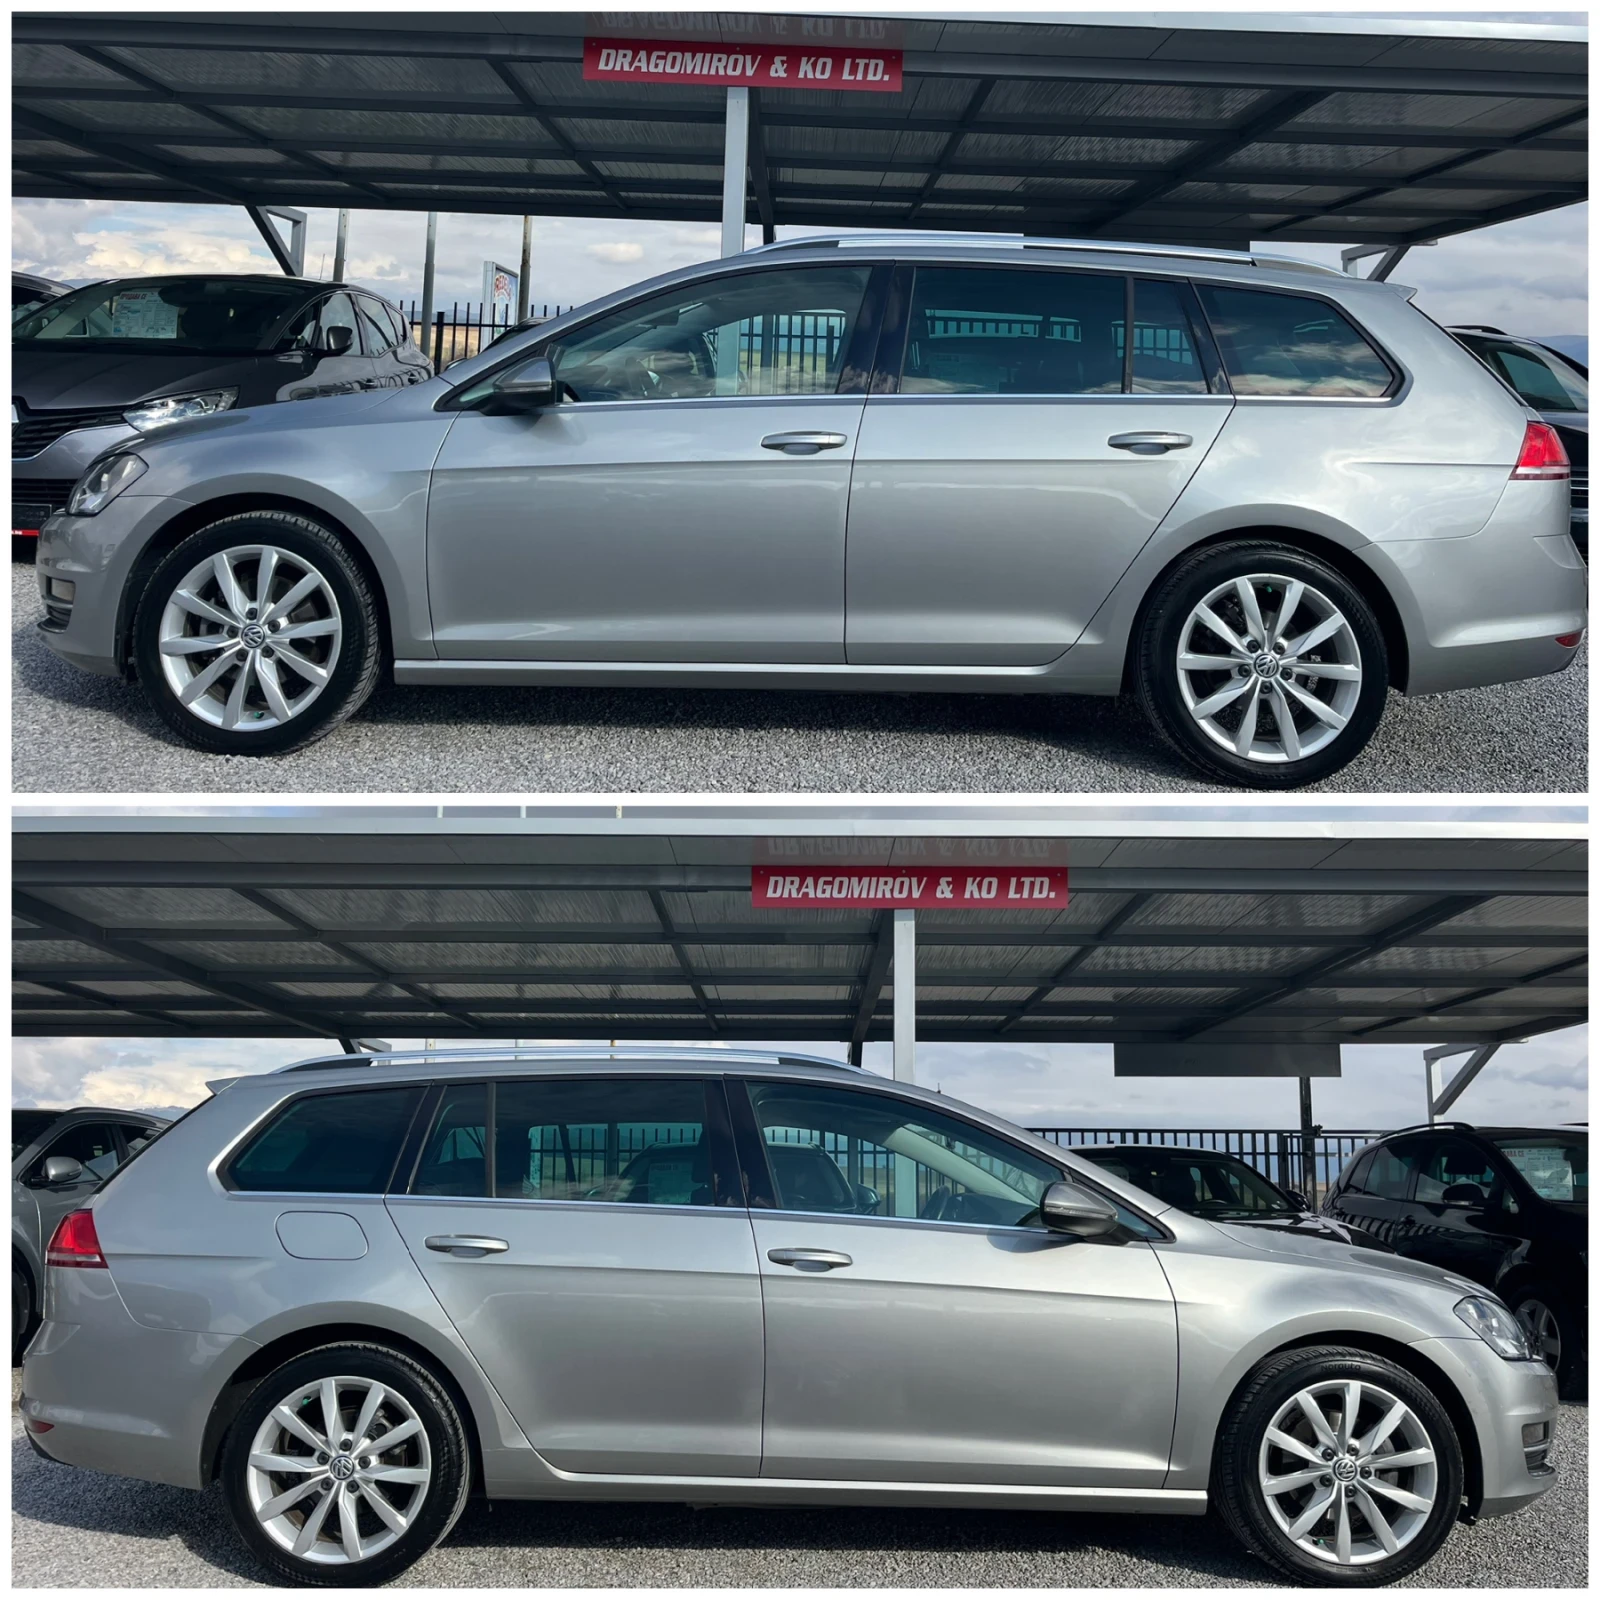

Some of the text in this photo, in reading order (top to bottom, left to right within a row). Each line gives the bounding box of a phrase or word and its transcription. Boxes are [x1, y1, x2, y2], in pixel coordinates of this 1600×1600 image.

[598, 49, 890, 81] DRAGOMIROV & KO LTD.
[766, 876, 1056, 899] DRAGOMIROV & KO LTD.
[1321, 1362, 1361, 1371] Norauto
